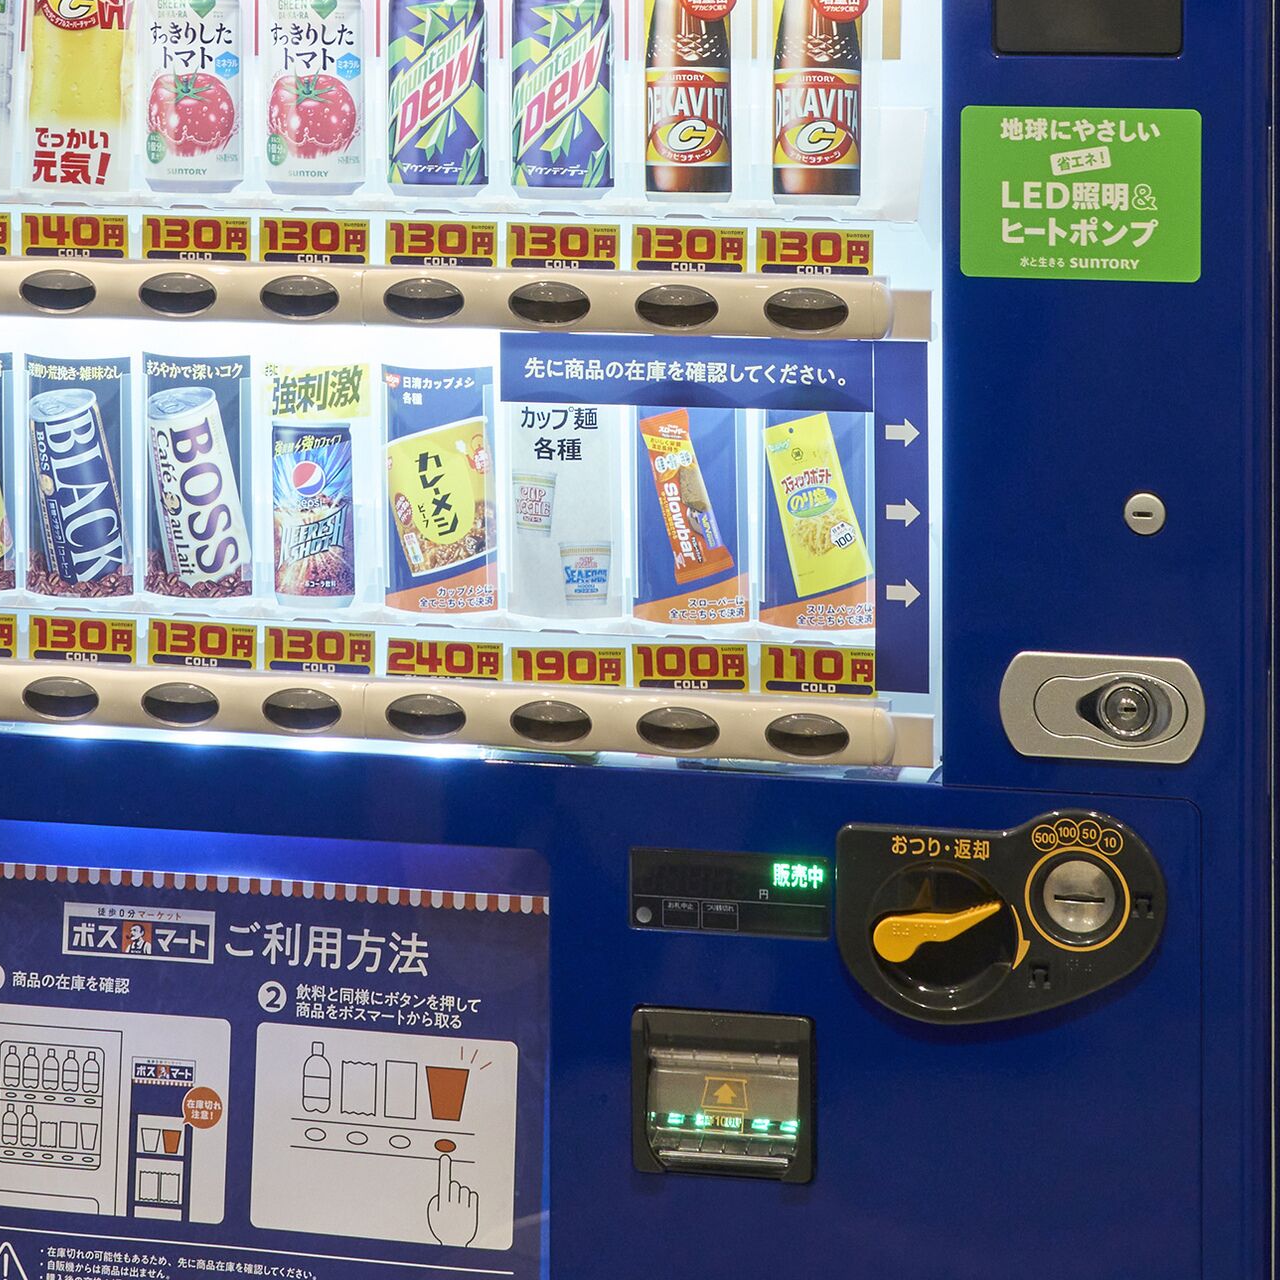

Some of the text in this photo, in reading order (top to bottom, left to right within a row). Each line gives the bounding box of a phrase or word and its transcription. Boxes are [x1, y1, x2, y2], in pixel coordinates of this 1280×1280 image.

[151, 22, 232, 45] すっきりした
[271, 23, 354, 46] すっきりした
[162, 47, 213, 70] トマト
[284, 48, 335, 71] トマト
[35, 128, 109, 148] でっかい
[1000, 118, 1161, 142] 地球にやさしい
[33, 151, 112, 185] 元気!
[26, 216, 124, 247] 140円
[1002, 217, 1159, 248] ヒートポンプ
[1020, 257, 1139, 270] 水と生きる SUNTORY
[147, 360, 243, 380] まろやかで深いコク
[524, 357, 846, 387] 先に商品の在庫を確認してください。
[272, 365, 363, 415] 強刺激
[403, 377, 475, 389] 日清カップメシ
[403, 392, 422, 405] 各種
[521, 407, 598, 430] カップ麺
[37, 431, 50, 470] BOSS
[534, 438, 582, 461] 各種
[781, 469, 832, 494] スティックポテト
[44, 410, 123, 583] BLACK
[169, 418, 240, 574] BOSS
[415, 452, 459, 536] カレーメシ
[790, 491, 829, 512] のり塩
[663, 482, 696, 561] Slowbar
[688, 597, 744, 608] スローバーは
[388, 640, 498, 674] 240円
[518, 650, 621, 681] 190円
[637, 647, 744, 678] 100円
[892, 836, 990, 860] おつり・返却
[1035, 827, 1116, 848] 500 100 50 10
[772, 862, 825, 889] 販売中
[759, 889, 769, 900] 円
[225, 921, 431, 977] ご利用方法
[12, 972, 130, 994] 商品の在庫を確認
[296, 984, 481, 1013] 飲料と同様にボタンを押して
[296, 1002, 462, 1028] 商品をボスマートから取る
[187, 1100, 221, 1110] 在庫切れ
